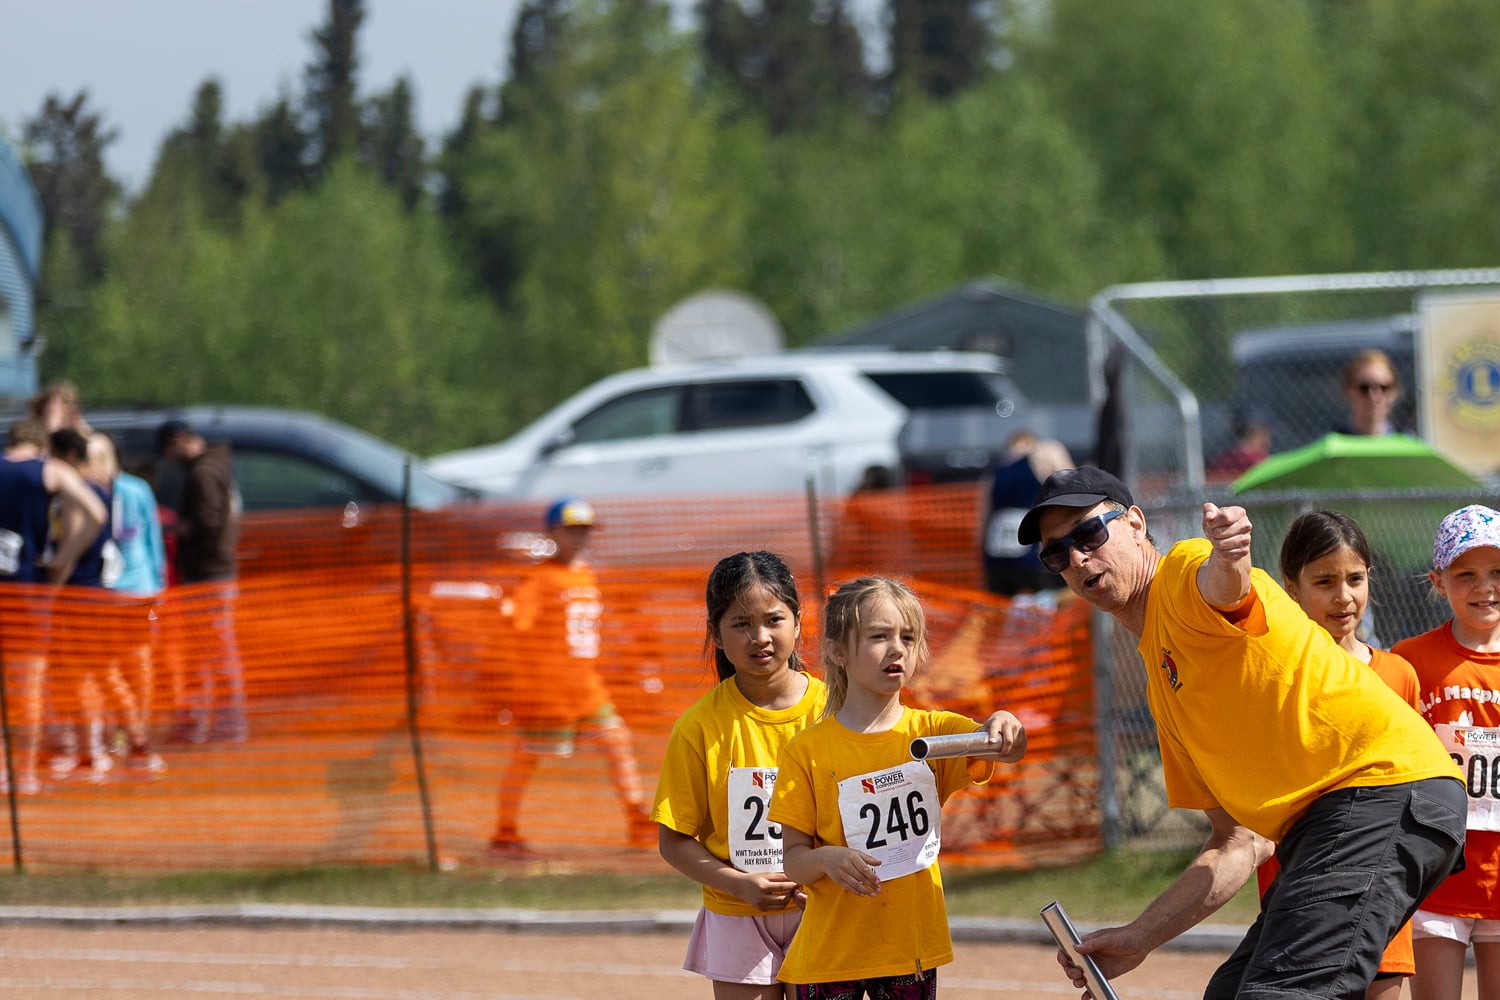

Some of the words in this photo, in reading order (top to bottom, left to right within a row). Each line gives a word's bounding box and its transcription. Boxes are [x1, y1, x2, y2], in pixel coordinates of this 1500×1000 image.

[1467, 732, 1497, 740] POWER
[874, 772, 904, 786] POWER
[860, 791, 929, 850] 246
[736, 849, 748, 857] NWT
[749, 849, 762, 857] Track
[769, 848, 783, 856] Field
